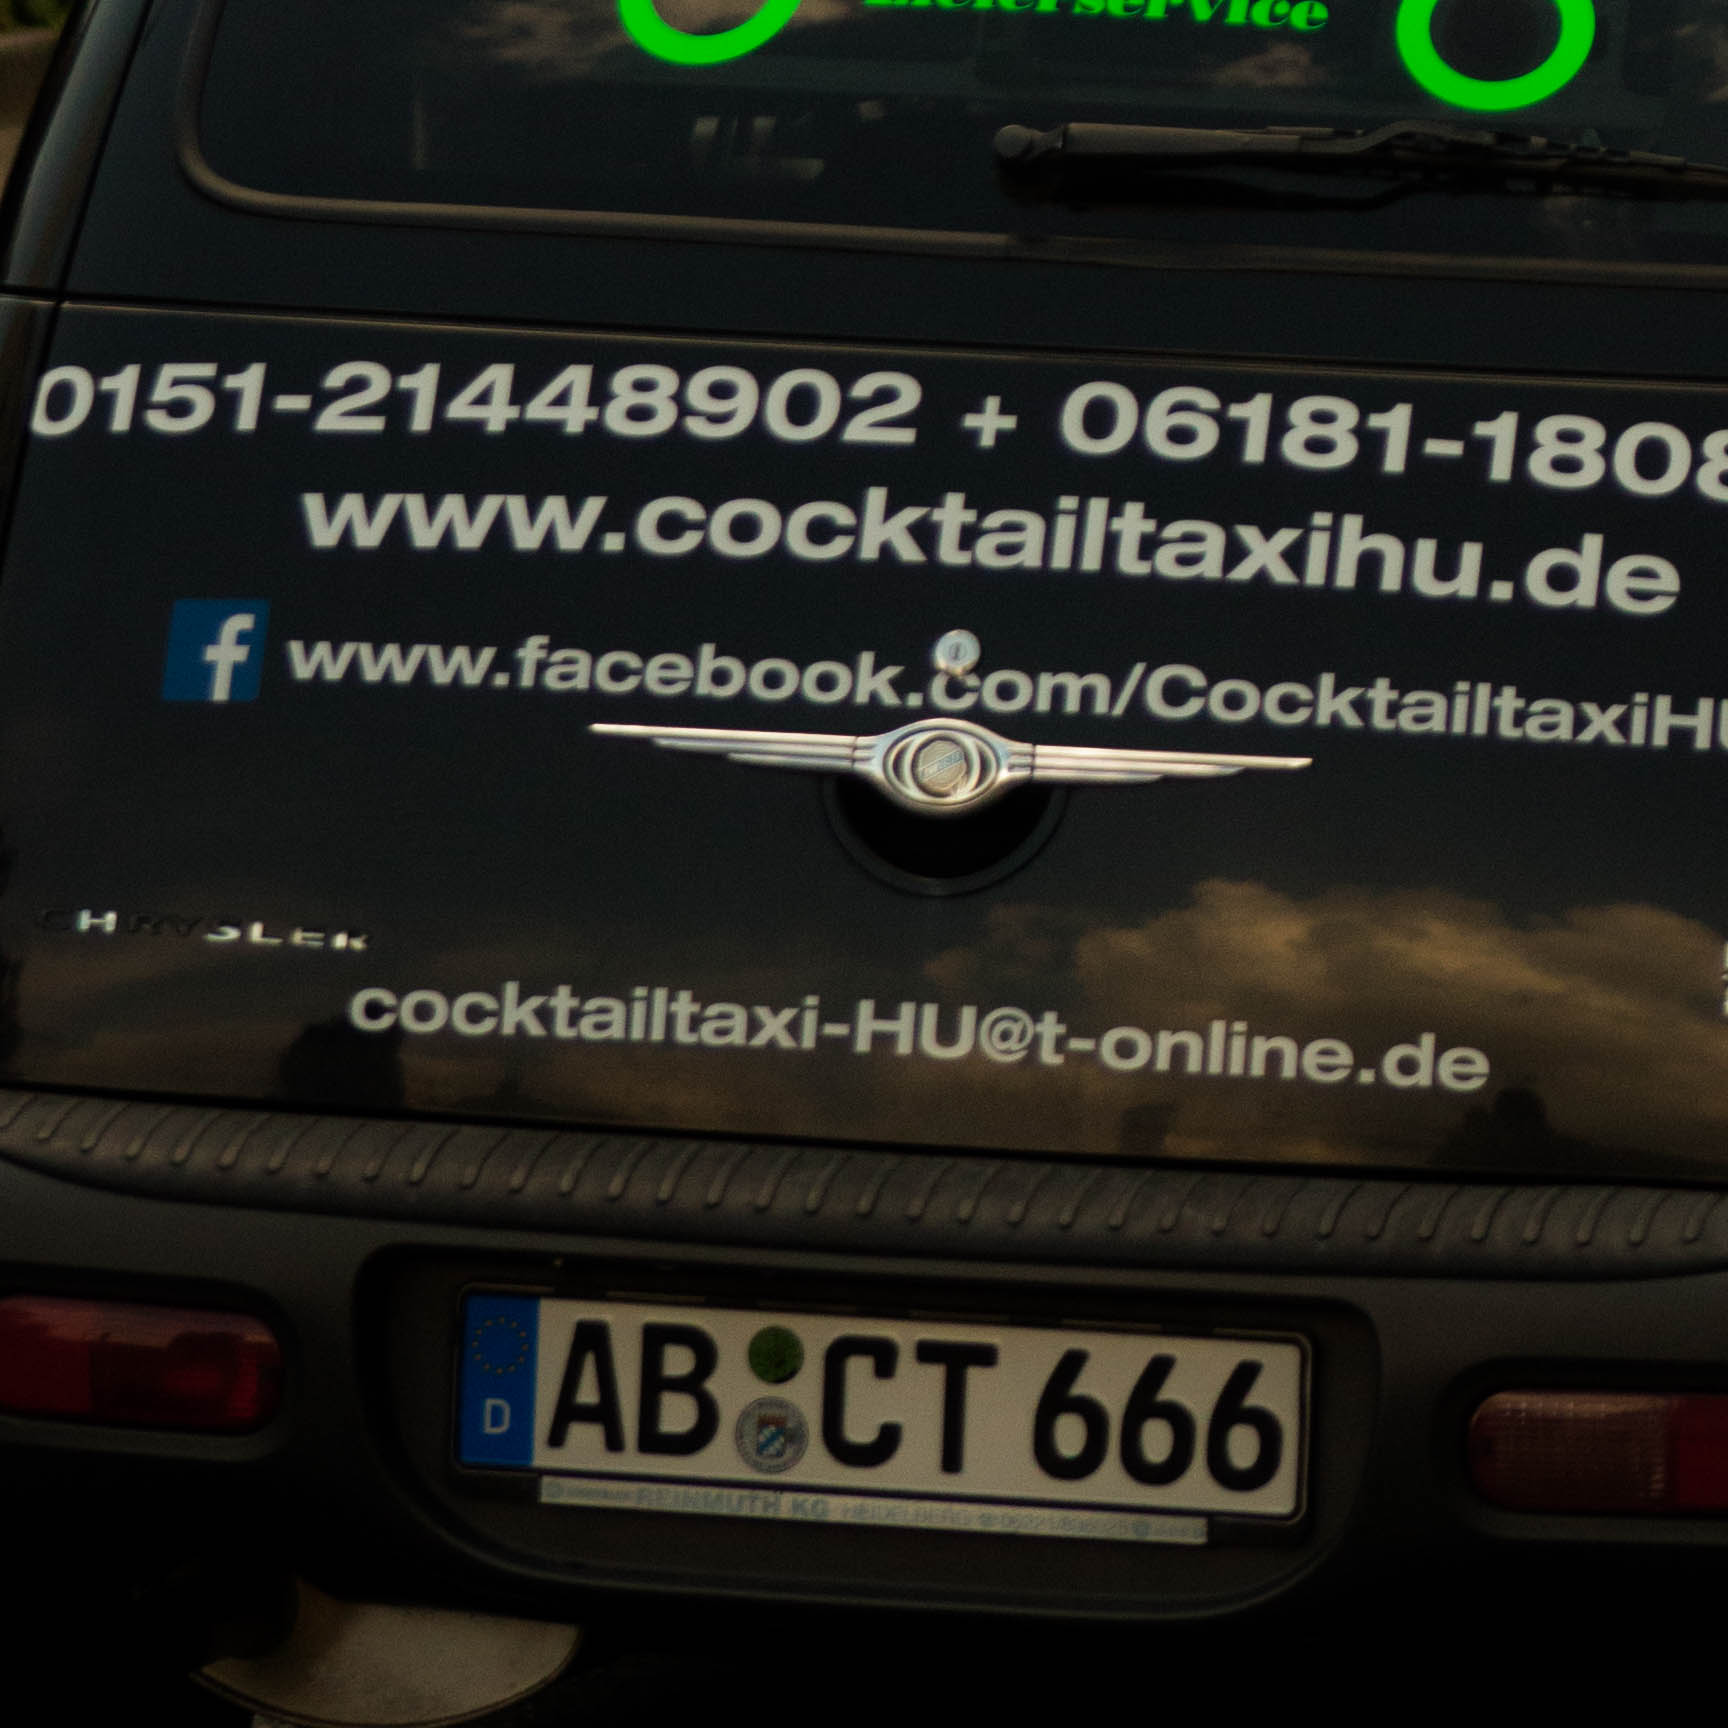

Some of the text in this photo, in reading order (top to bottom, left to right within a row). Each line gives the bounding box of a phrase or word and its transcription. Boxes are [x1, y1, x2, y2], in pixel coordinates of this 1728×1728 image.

[30, 359, 923, 445] 0151-21448902
[961, 394, 1018, 450] +
[301, 485, 1682, 616] www.cocktailtaxihu.de
[348, 980, 1491, 1092] cocktailtaxi-HU@t-online.de
[481, 1397, 512, 1436] D
[546, 1319, 722, 1457] AB
[820, 1333, 1000, 1475] CT
[1032, 1347, 1286, 1493] 666
